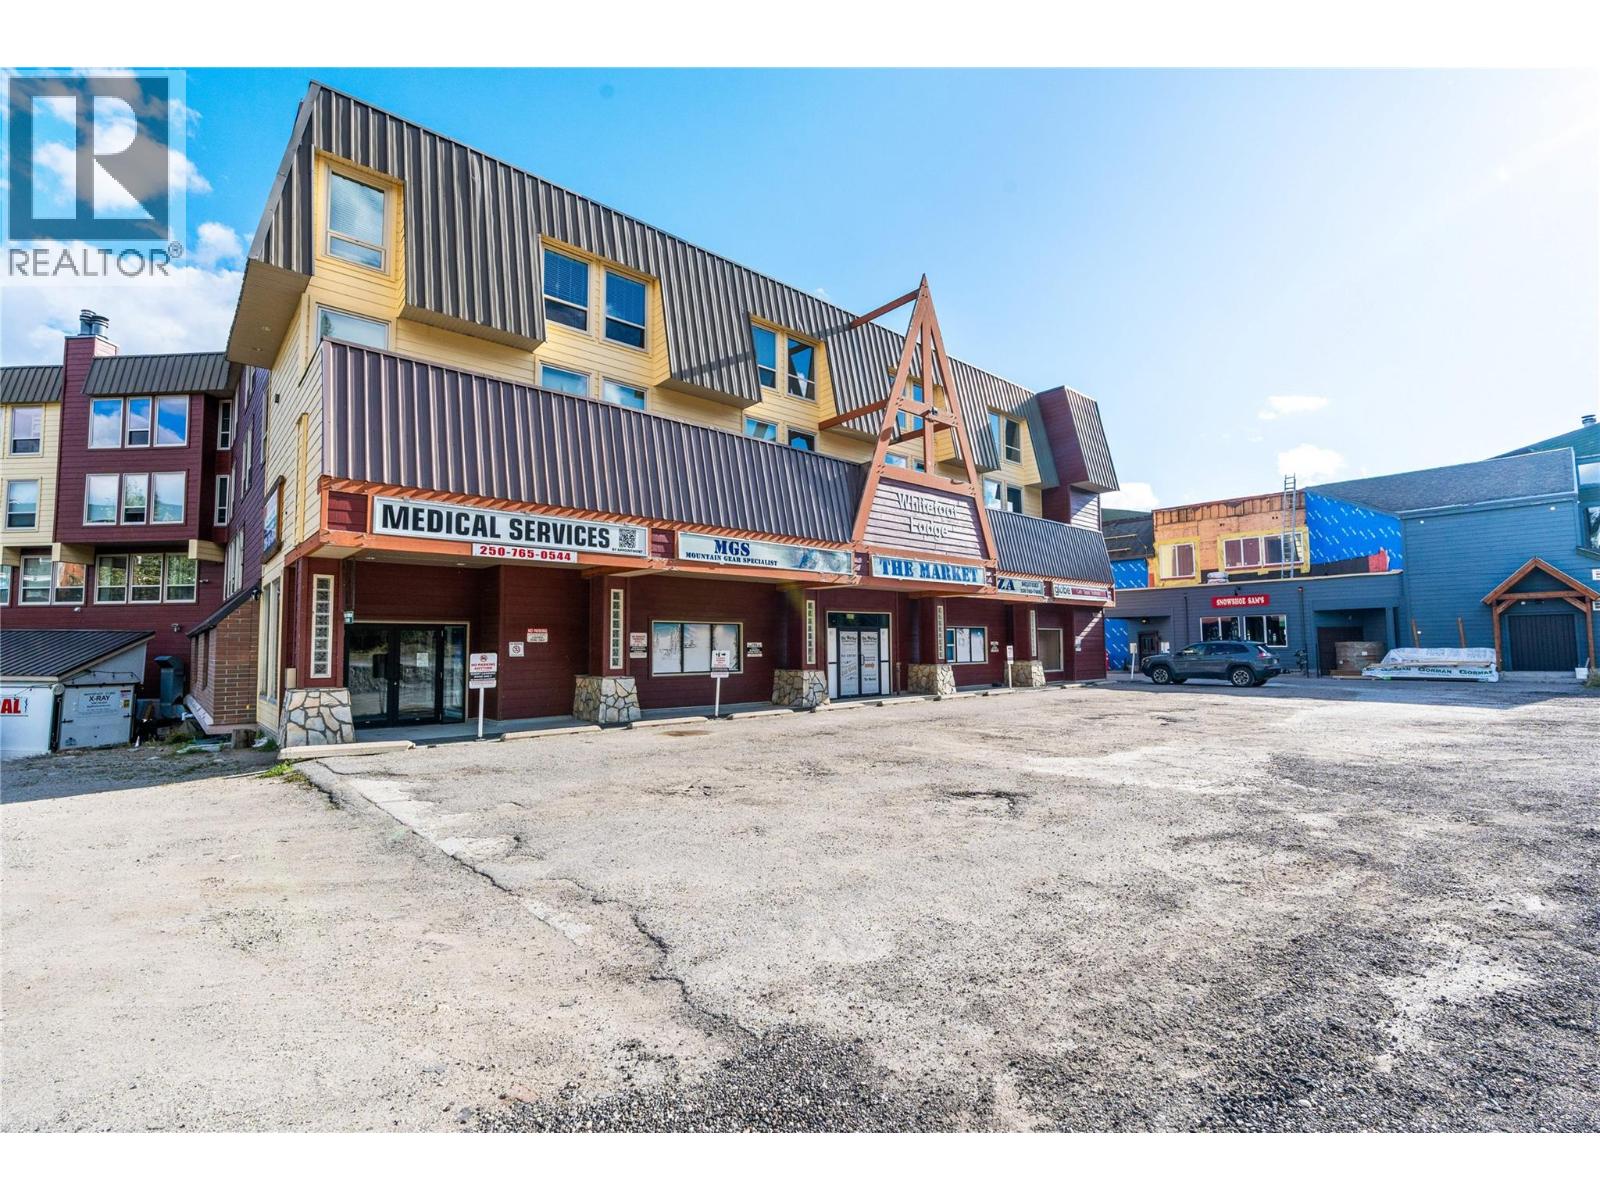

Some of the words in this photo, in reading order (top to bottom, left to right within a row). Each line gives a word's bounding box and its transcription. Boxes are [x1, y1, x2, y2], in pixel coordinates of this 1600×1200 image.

[382, 503, 501, 538] MEDICAL
[509, 517, 610, 548] SERVICES
[910, 516, 949, 541] Lodge
[479, 545, 571, 561] 250-765-0544
[714, 539, 751, 557] MGS
[685, 551, 722, 561] MOUNTAIN
[723, 555, 741, 563] GEAR
[743, 557, 778, 566] SPECIALIST
[879, 557, 914, 577] THE
[919, 561, 978, 583] MARKET
[1216, 598, 1246, 606] SNOWSHOE
